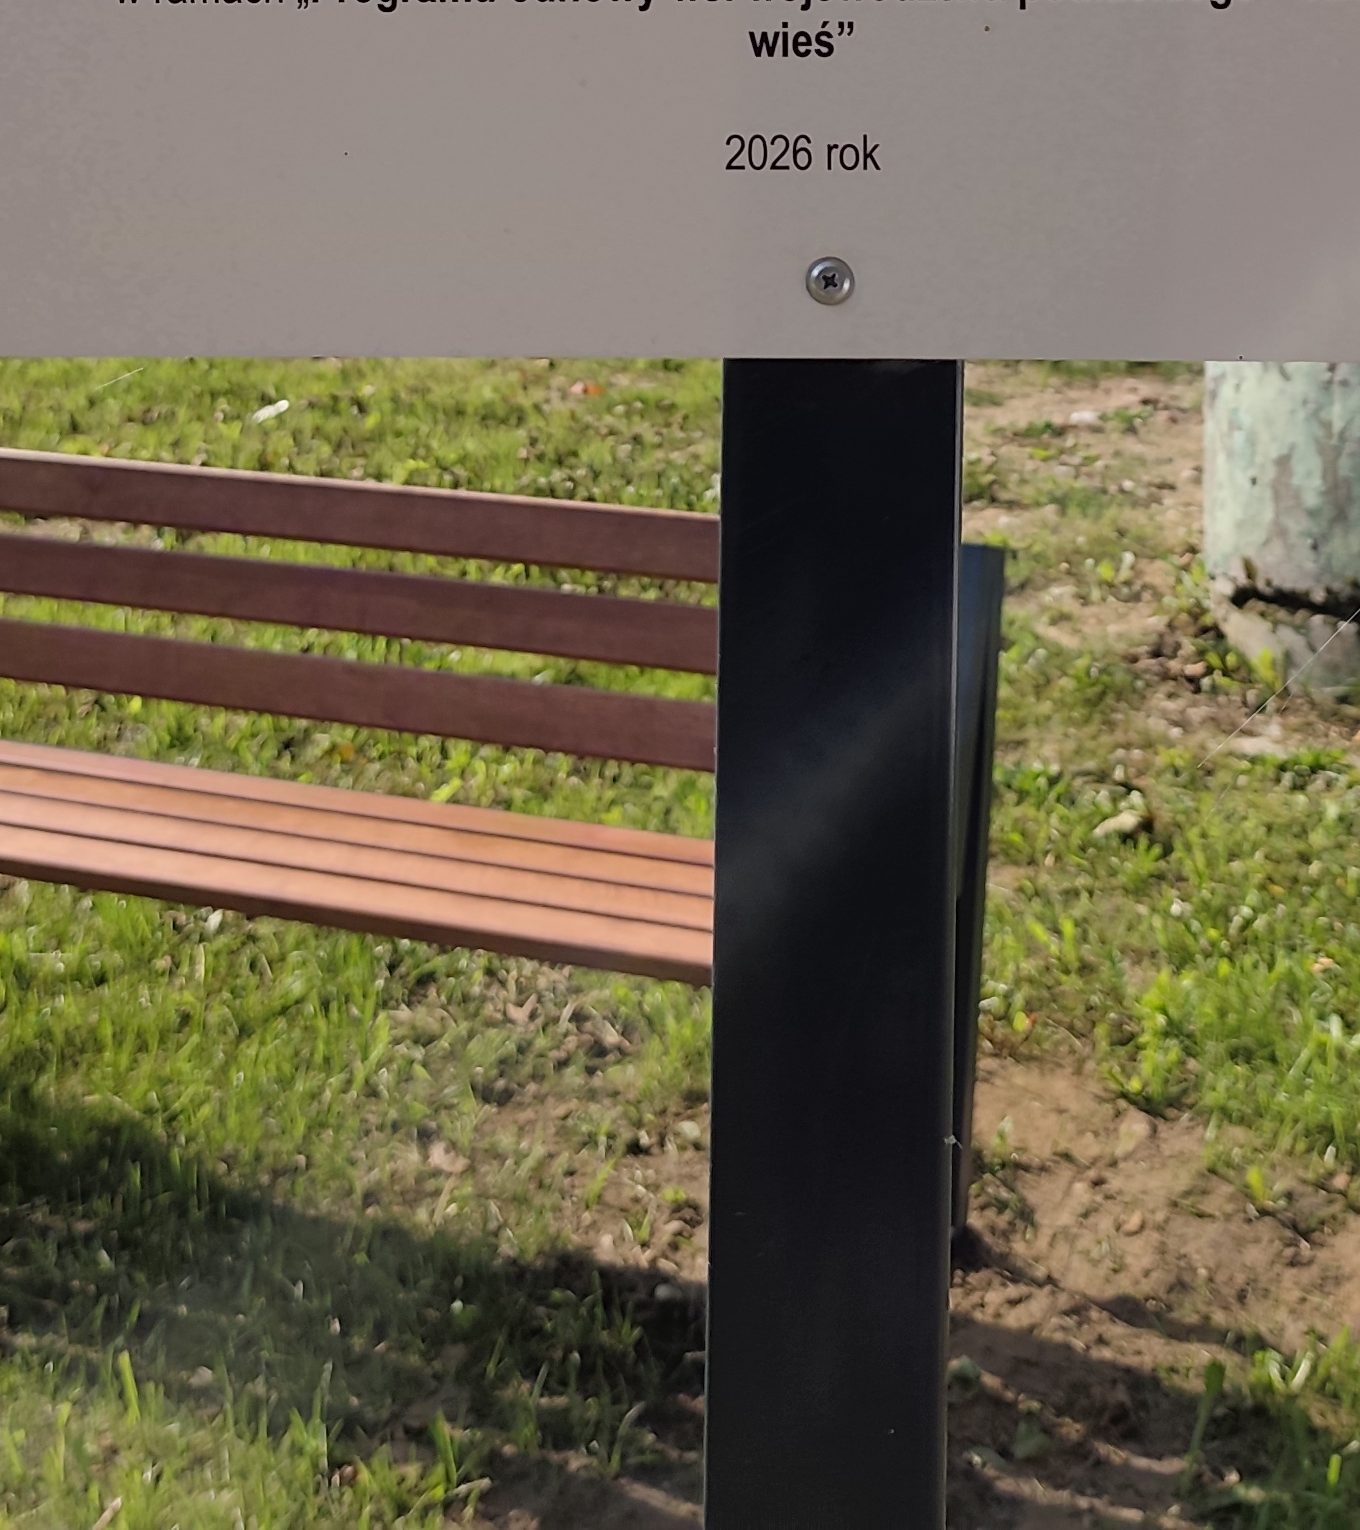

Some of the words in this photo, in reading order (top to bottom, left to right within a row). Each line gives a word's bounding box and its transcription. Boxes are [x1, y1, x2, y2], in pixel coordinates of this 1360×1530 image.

[748, 21, 854, 57] wieś”
[725, 134, 812, 170] 2026
[827, 134, 881, 170] rok
